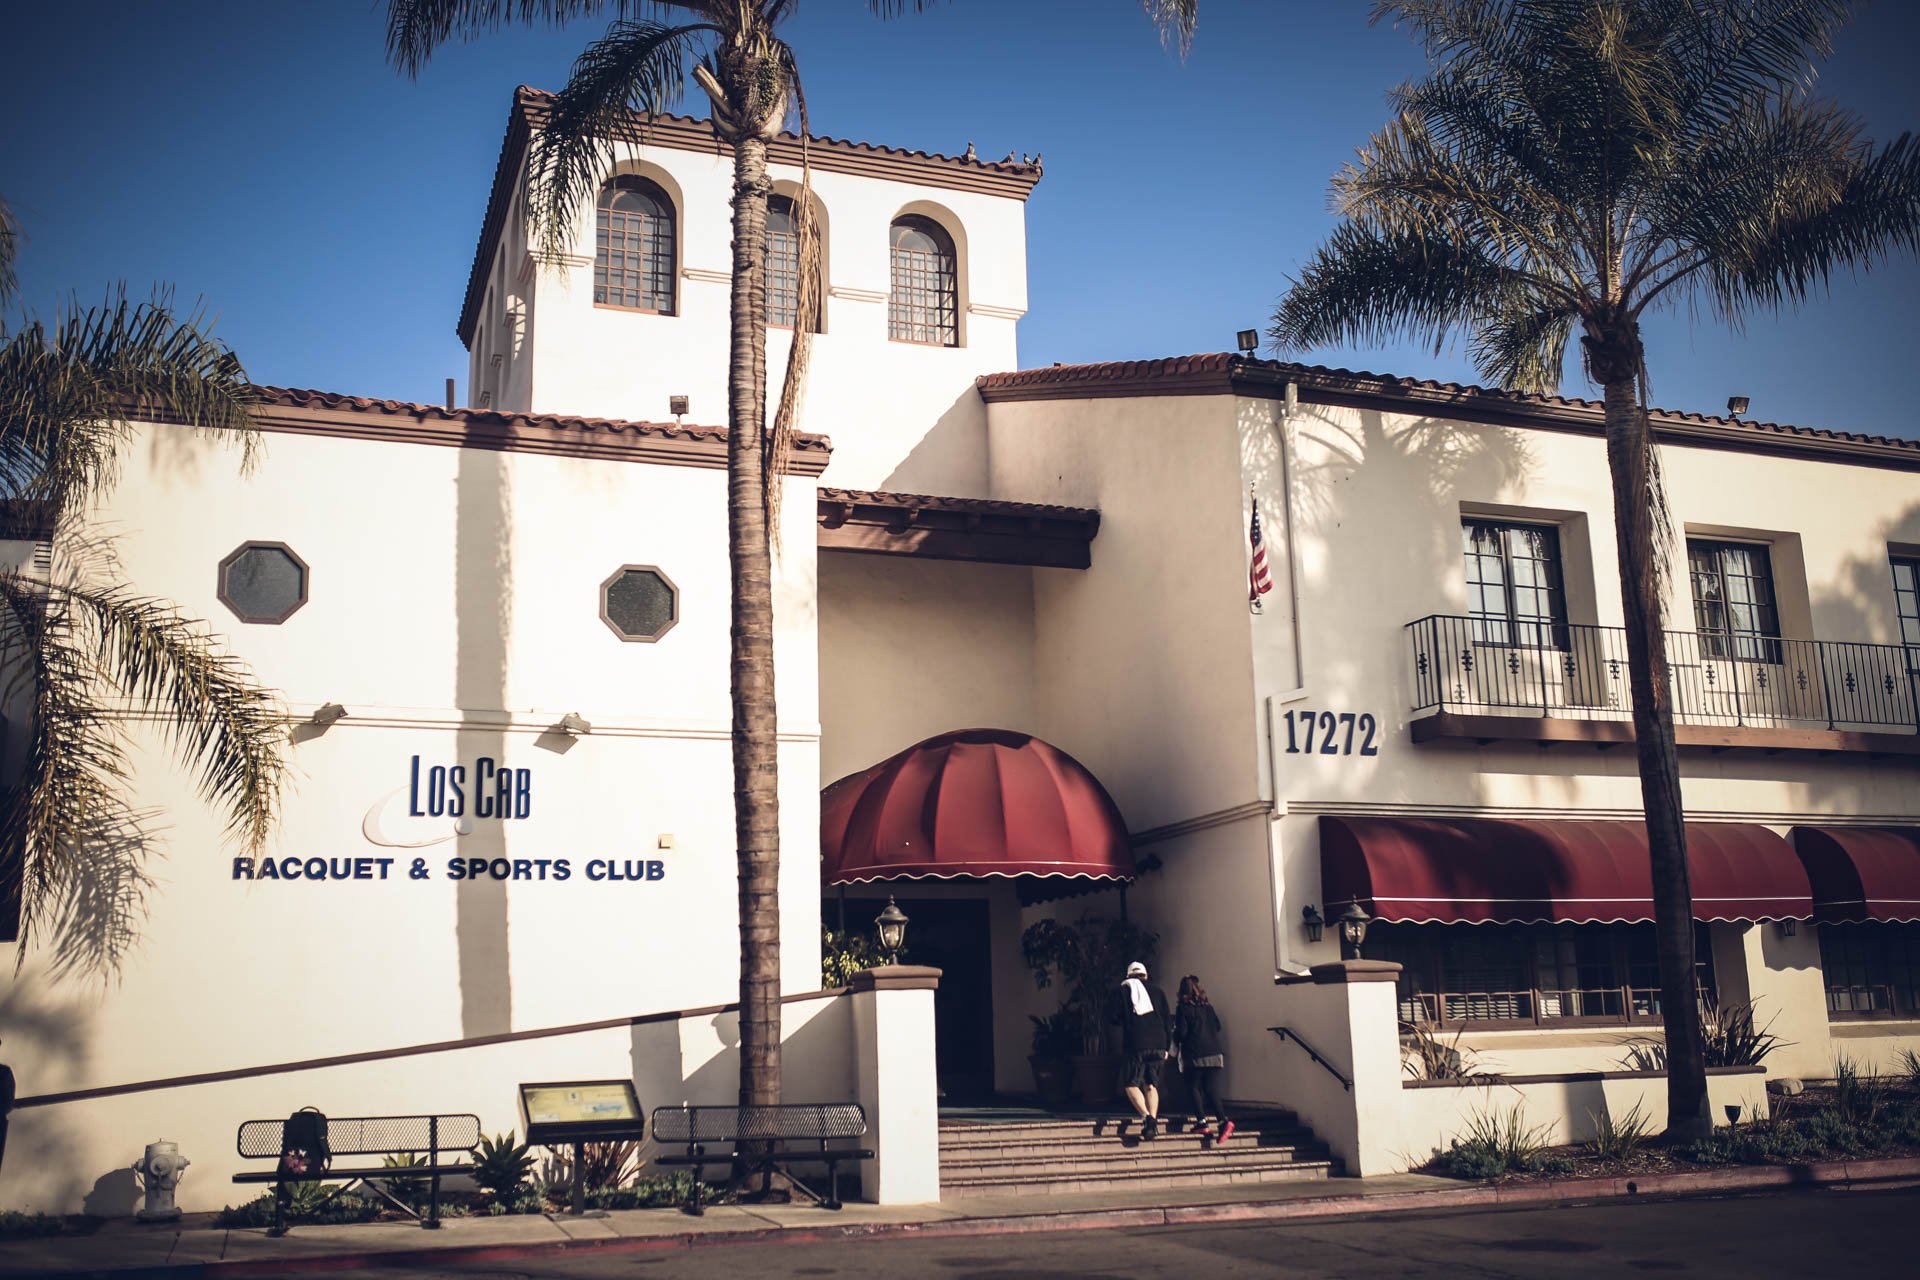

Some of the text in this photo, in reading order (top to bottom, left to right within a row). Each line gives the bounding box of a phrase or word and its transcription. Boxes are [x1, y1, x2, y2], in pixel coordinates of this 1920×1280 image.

[1283, 710, 1379, 756] 17272
[410, 755, 531, 819] LOS CAB
[232, 856, 666, 881] RACQUET & SPORTS CLUB
